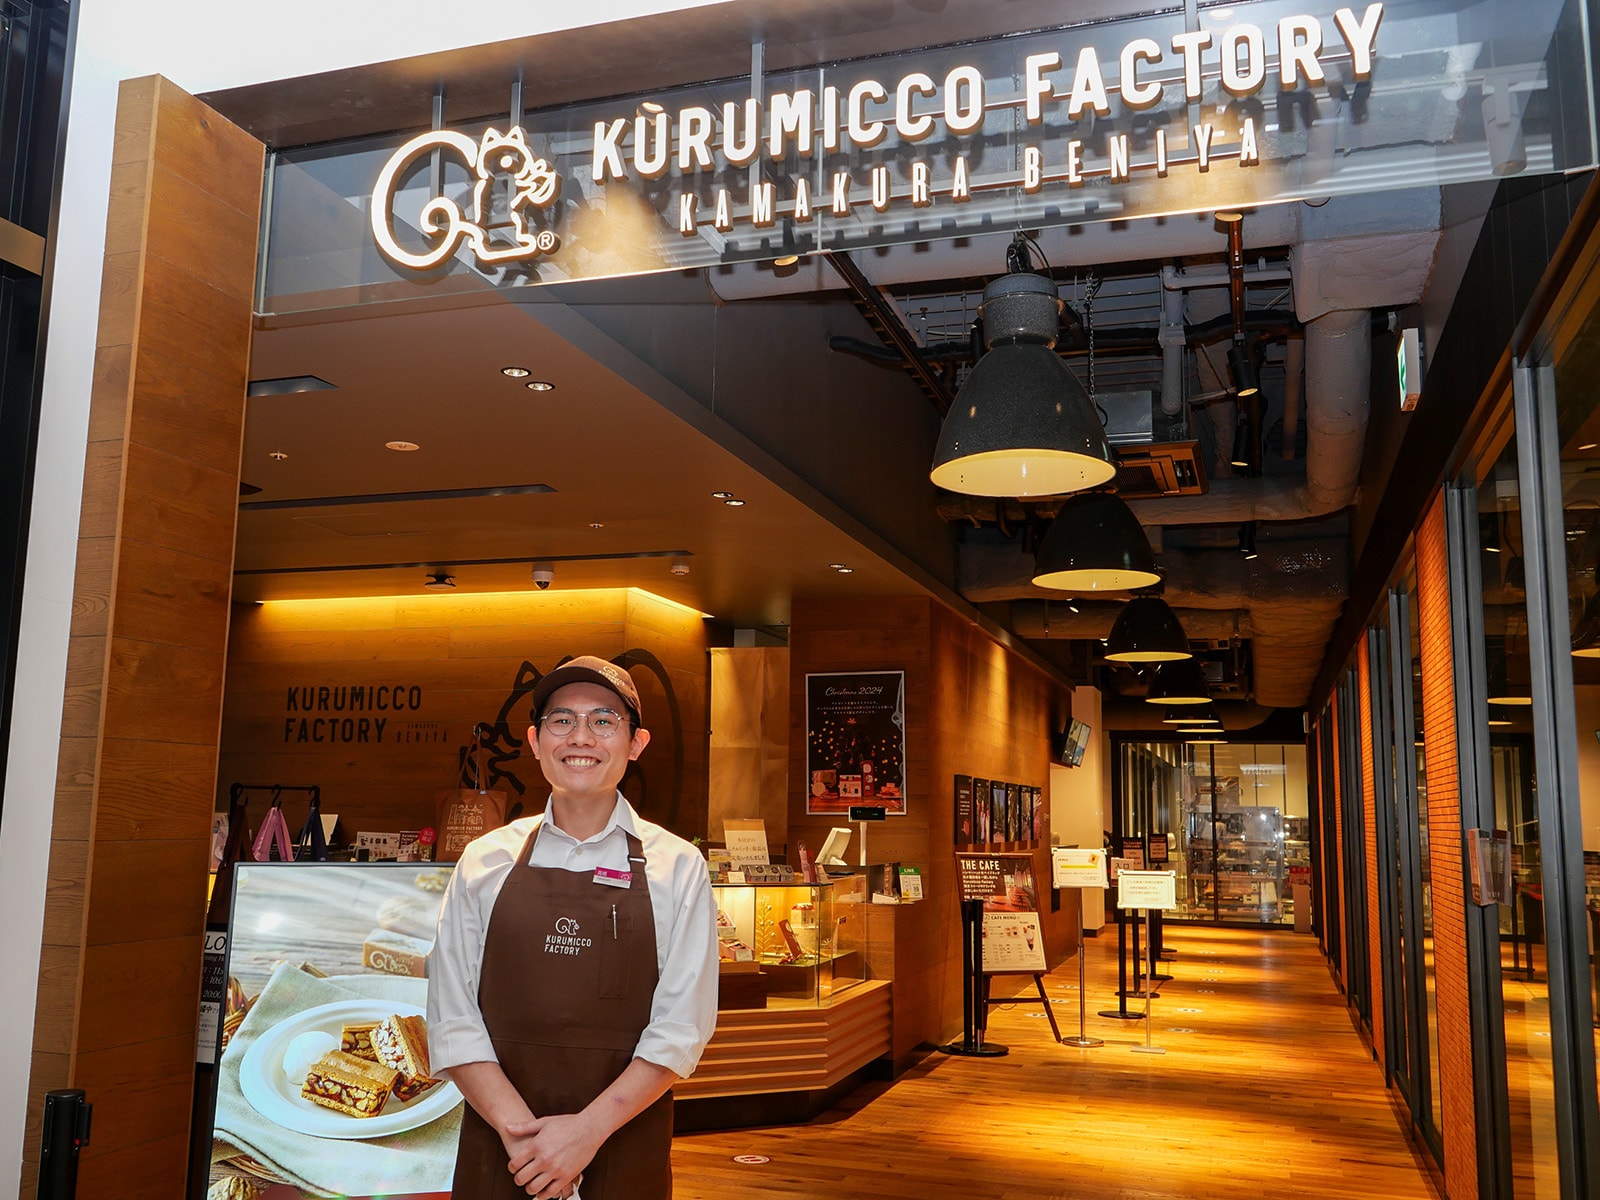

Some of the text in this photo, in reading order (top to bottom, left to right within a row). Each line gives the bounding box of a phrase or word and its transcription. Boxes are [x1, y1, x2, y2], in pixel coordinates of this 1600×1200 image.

[592, 3, 1384, 184] KURUMICCO FACTORY
[679, 118, 1259, 236] KAMAKURA BENIYA
[857, 686, 883, 696] 2024
[286, 685, 422, 711] KURUMICCO
[284, 717, 387, 743] FACTORY
[961, 860, 1000, 871] THE CAFE
[1114, 862, 1130, 870] 入口
[545, 934, 592, 947] KURUMICCO
[544, 944, 580, 956] FACTORY
